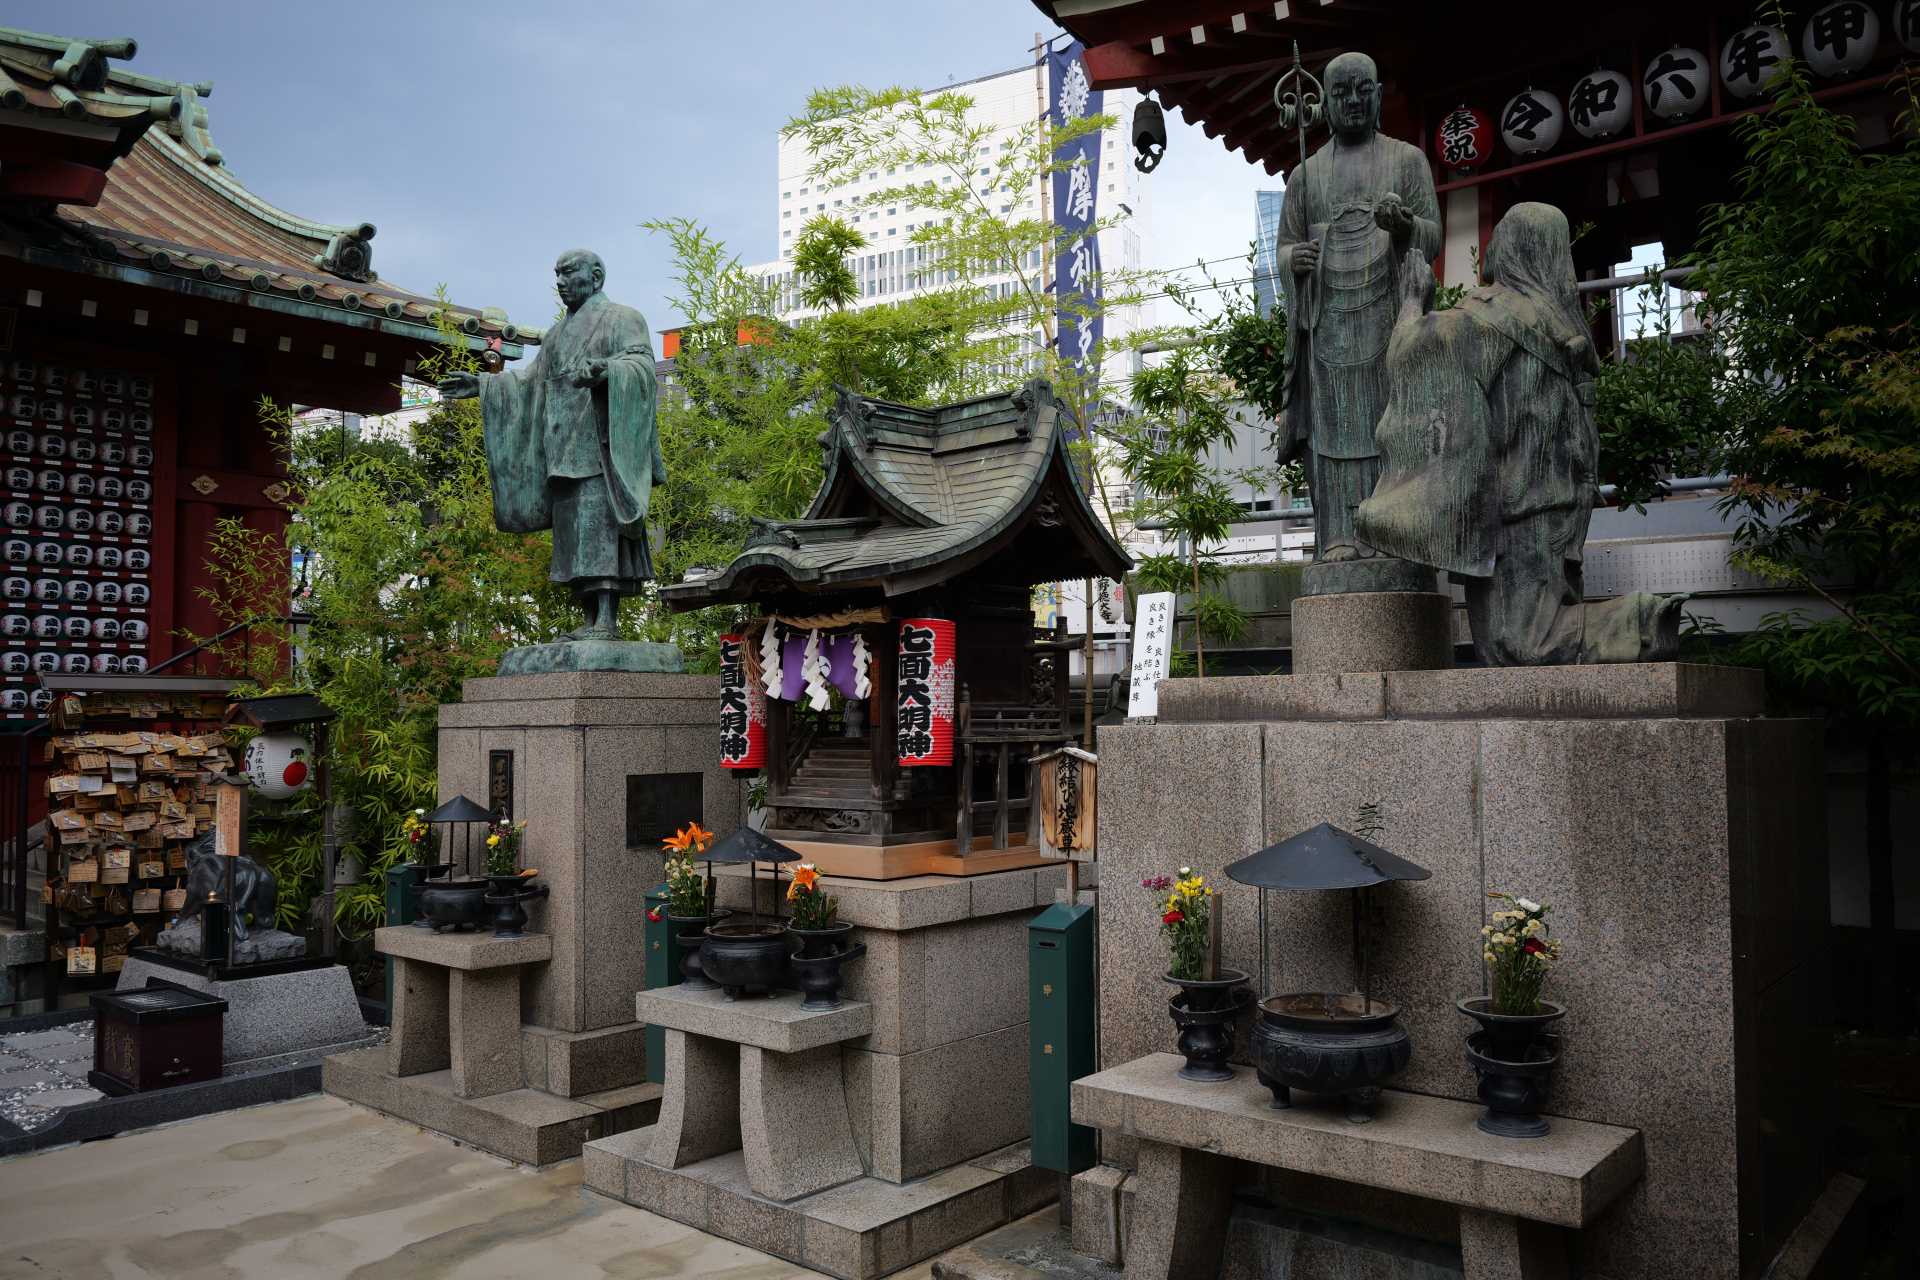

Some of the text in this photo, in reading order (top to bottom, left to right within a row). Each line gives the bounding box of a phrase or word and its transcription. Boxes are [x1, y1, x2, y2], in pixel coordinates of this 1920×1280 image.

[1442, 109, 1479, 164] 奉祝
[1066, 147, 1097, 408] 摩利支
[1143, 603, 1157, 681] 良き縁を結ぶ
[1156, 602, 1167, 634] 良き友
[720, 639, 749, 763] 七面大明神
[900, 624, 936, 759] 七面大明神
[1132, 662, 1143, 702] 地蔵尊
[1057, 755, 1080, 858] 縁結び地蔵尊
